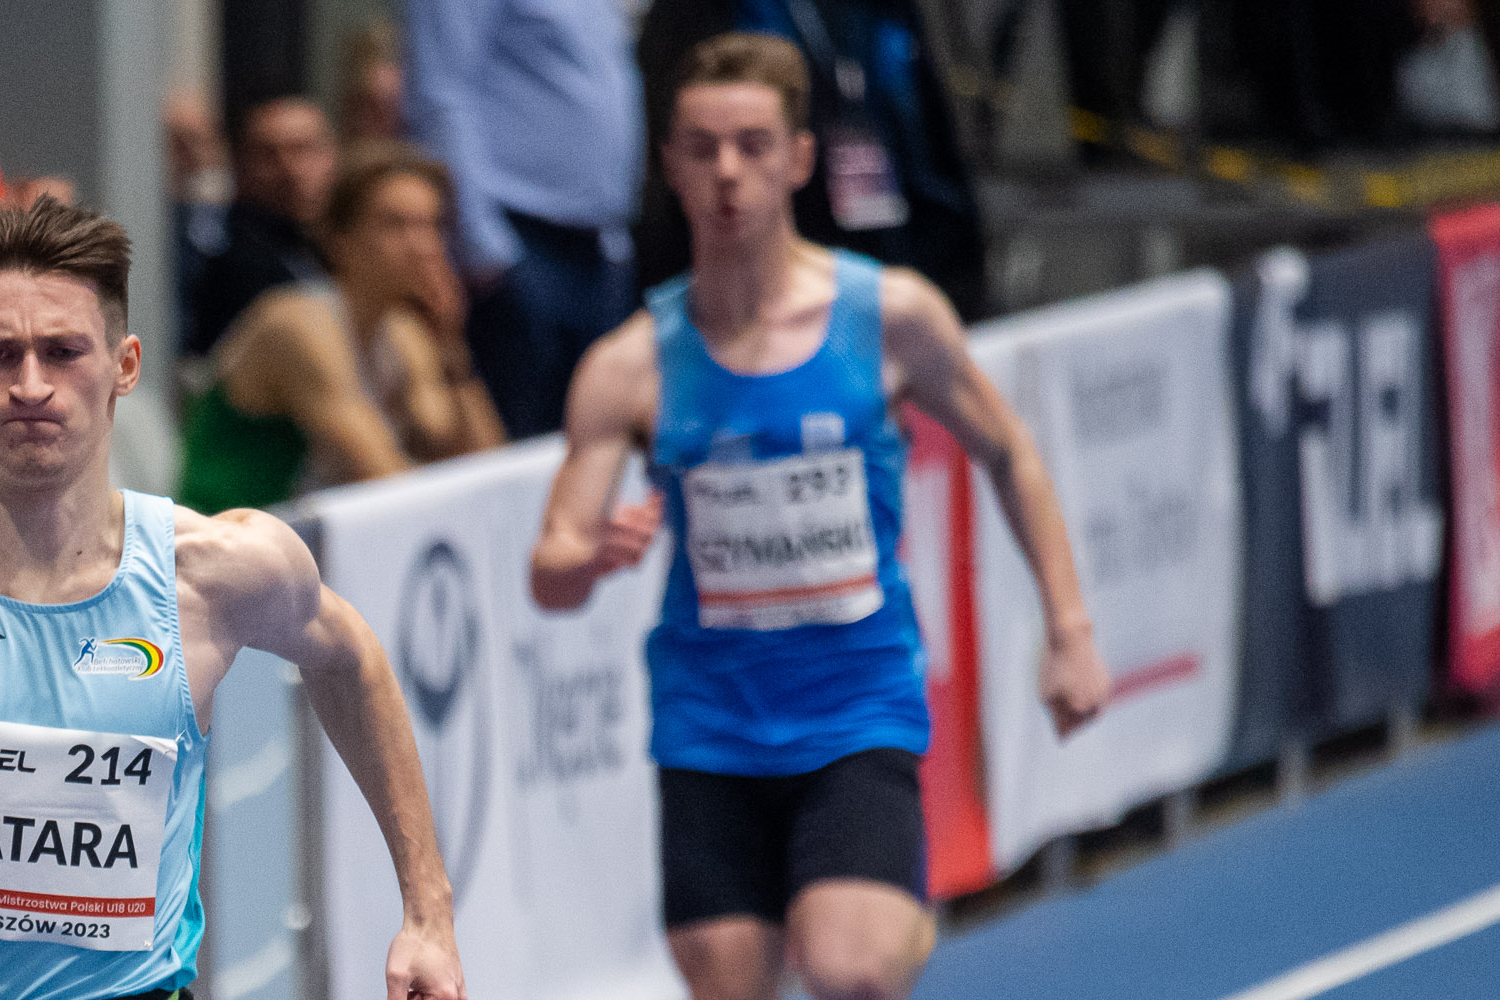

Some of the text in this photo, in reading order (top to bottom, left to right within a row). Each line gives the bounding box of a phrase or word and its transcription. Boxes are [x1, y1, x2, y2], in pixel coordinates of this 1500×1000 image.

[64, 744, 154, 785] 214
[70, 901, 104, 914] Polski
[106, 903, 125, 914] U18
[127, 902, 146, 914] U20
[61, 921, 111, 939] 2023
